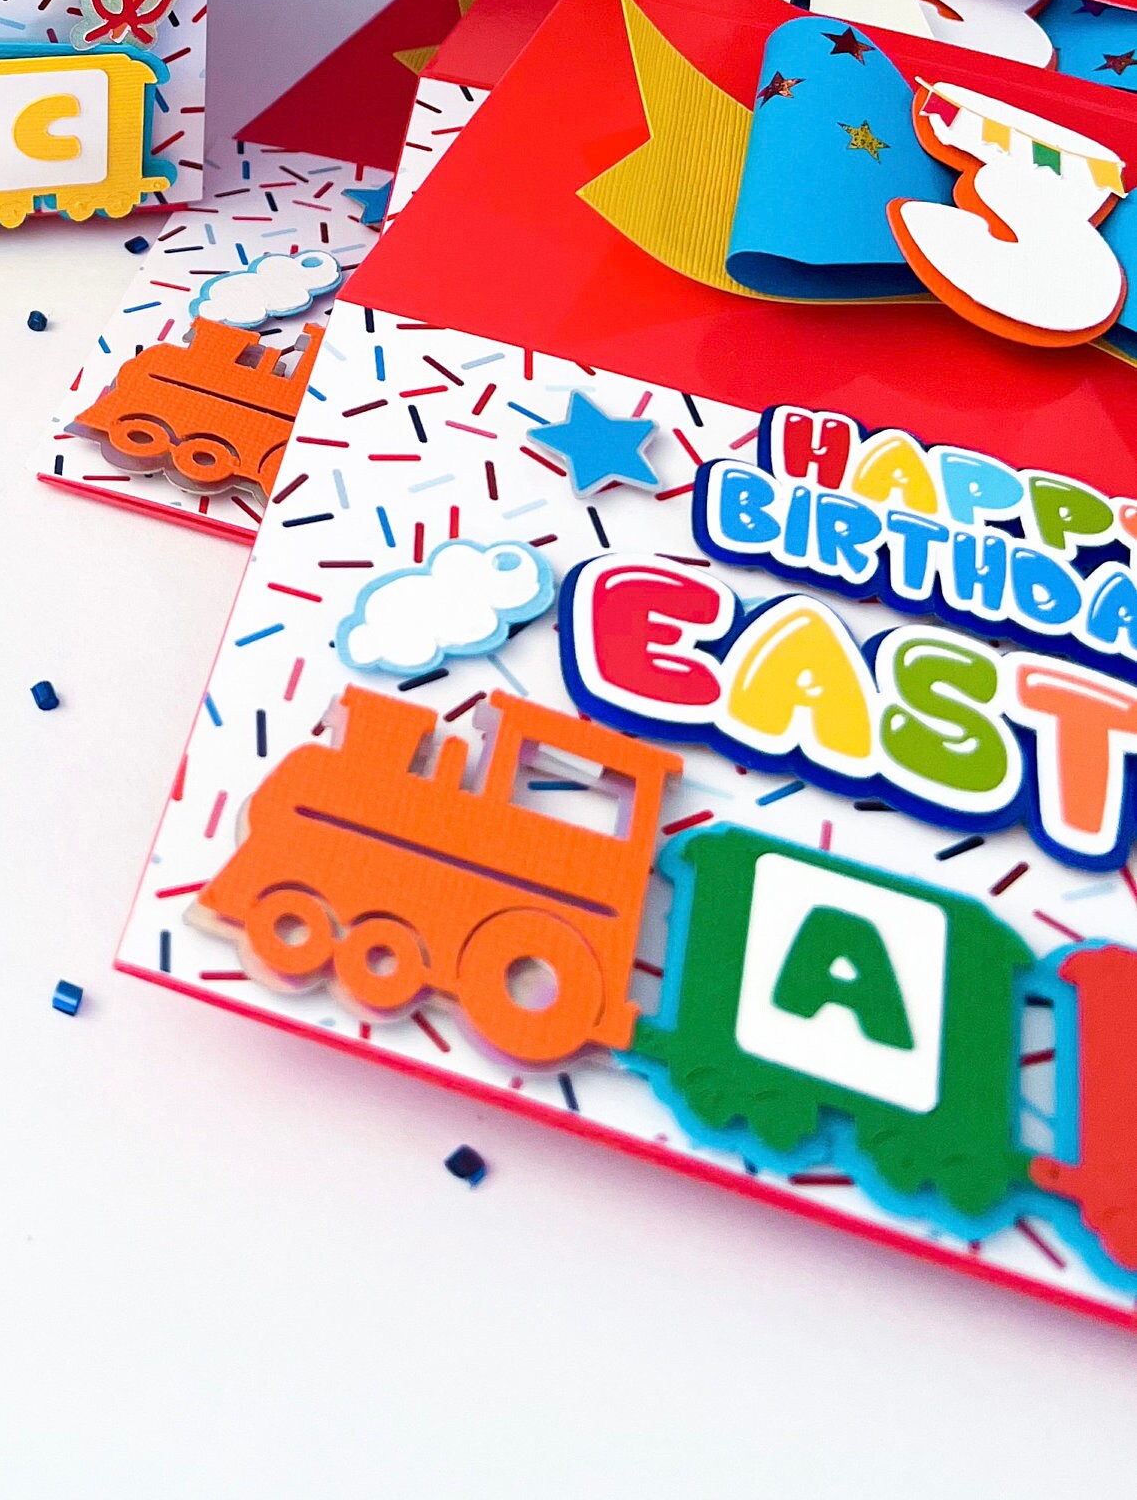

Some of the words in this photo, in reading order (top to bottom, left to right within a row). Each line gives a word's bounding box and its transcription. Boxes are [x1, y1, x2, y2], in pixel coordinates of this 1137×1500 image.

[12, 93, 81, 161] C
[900, 81, 1125, 332] 3
[591, 565, 1137, 835] EAST
[771, 905, 915, 1051] A
